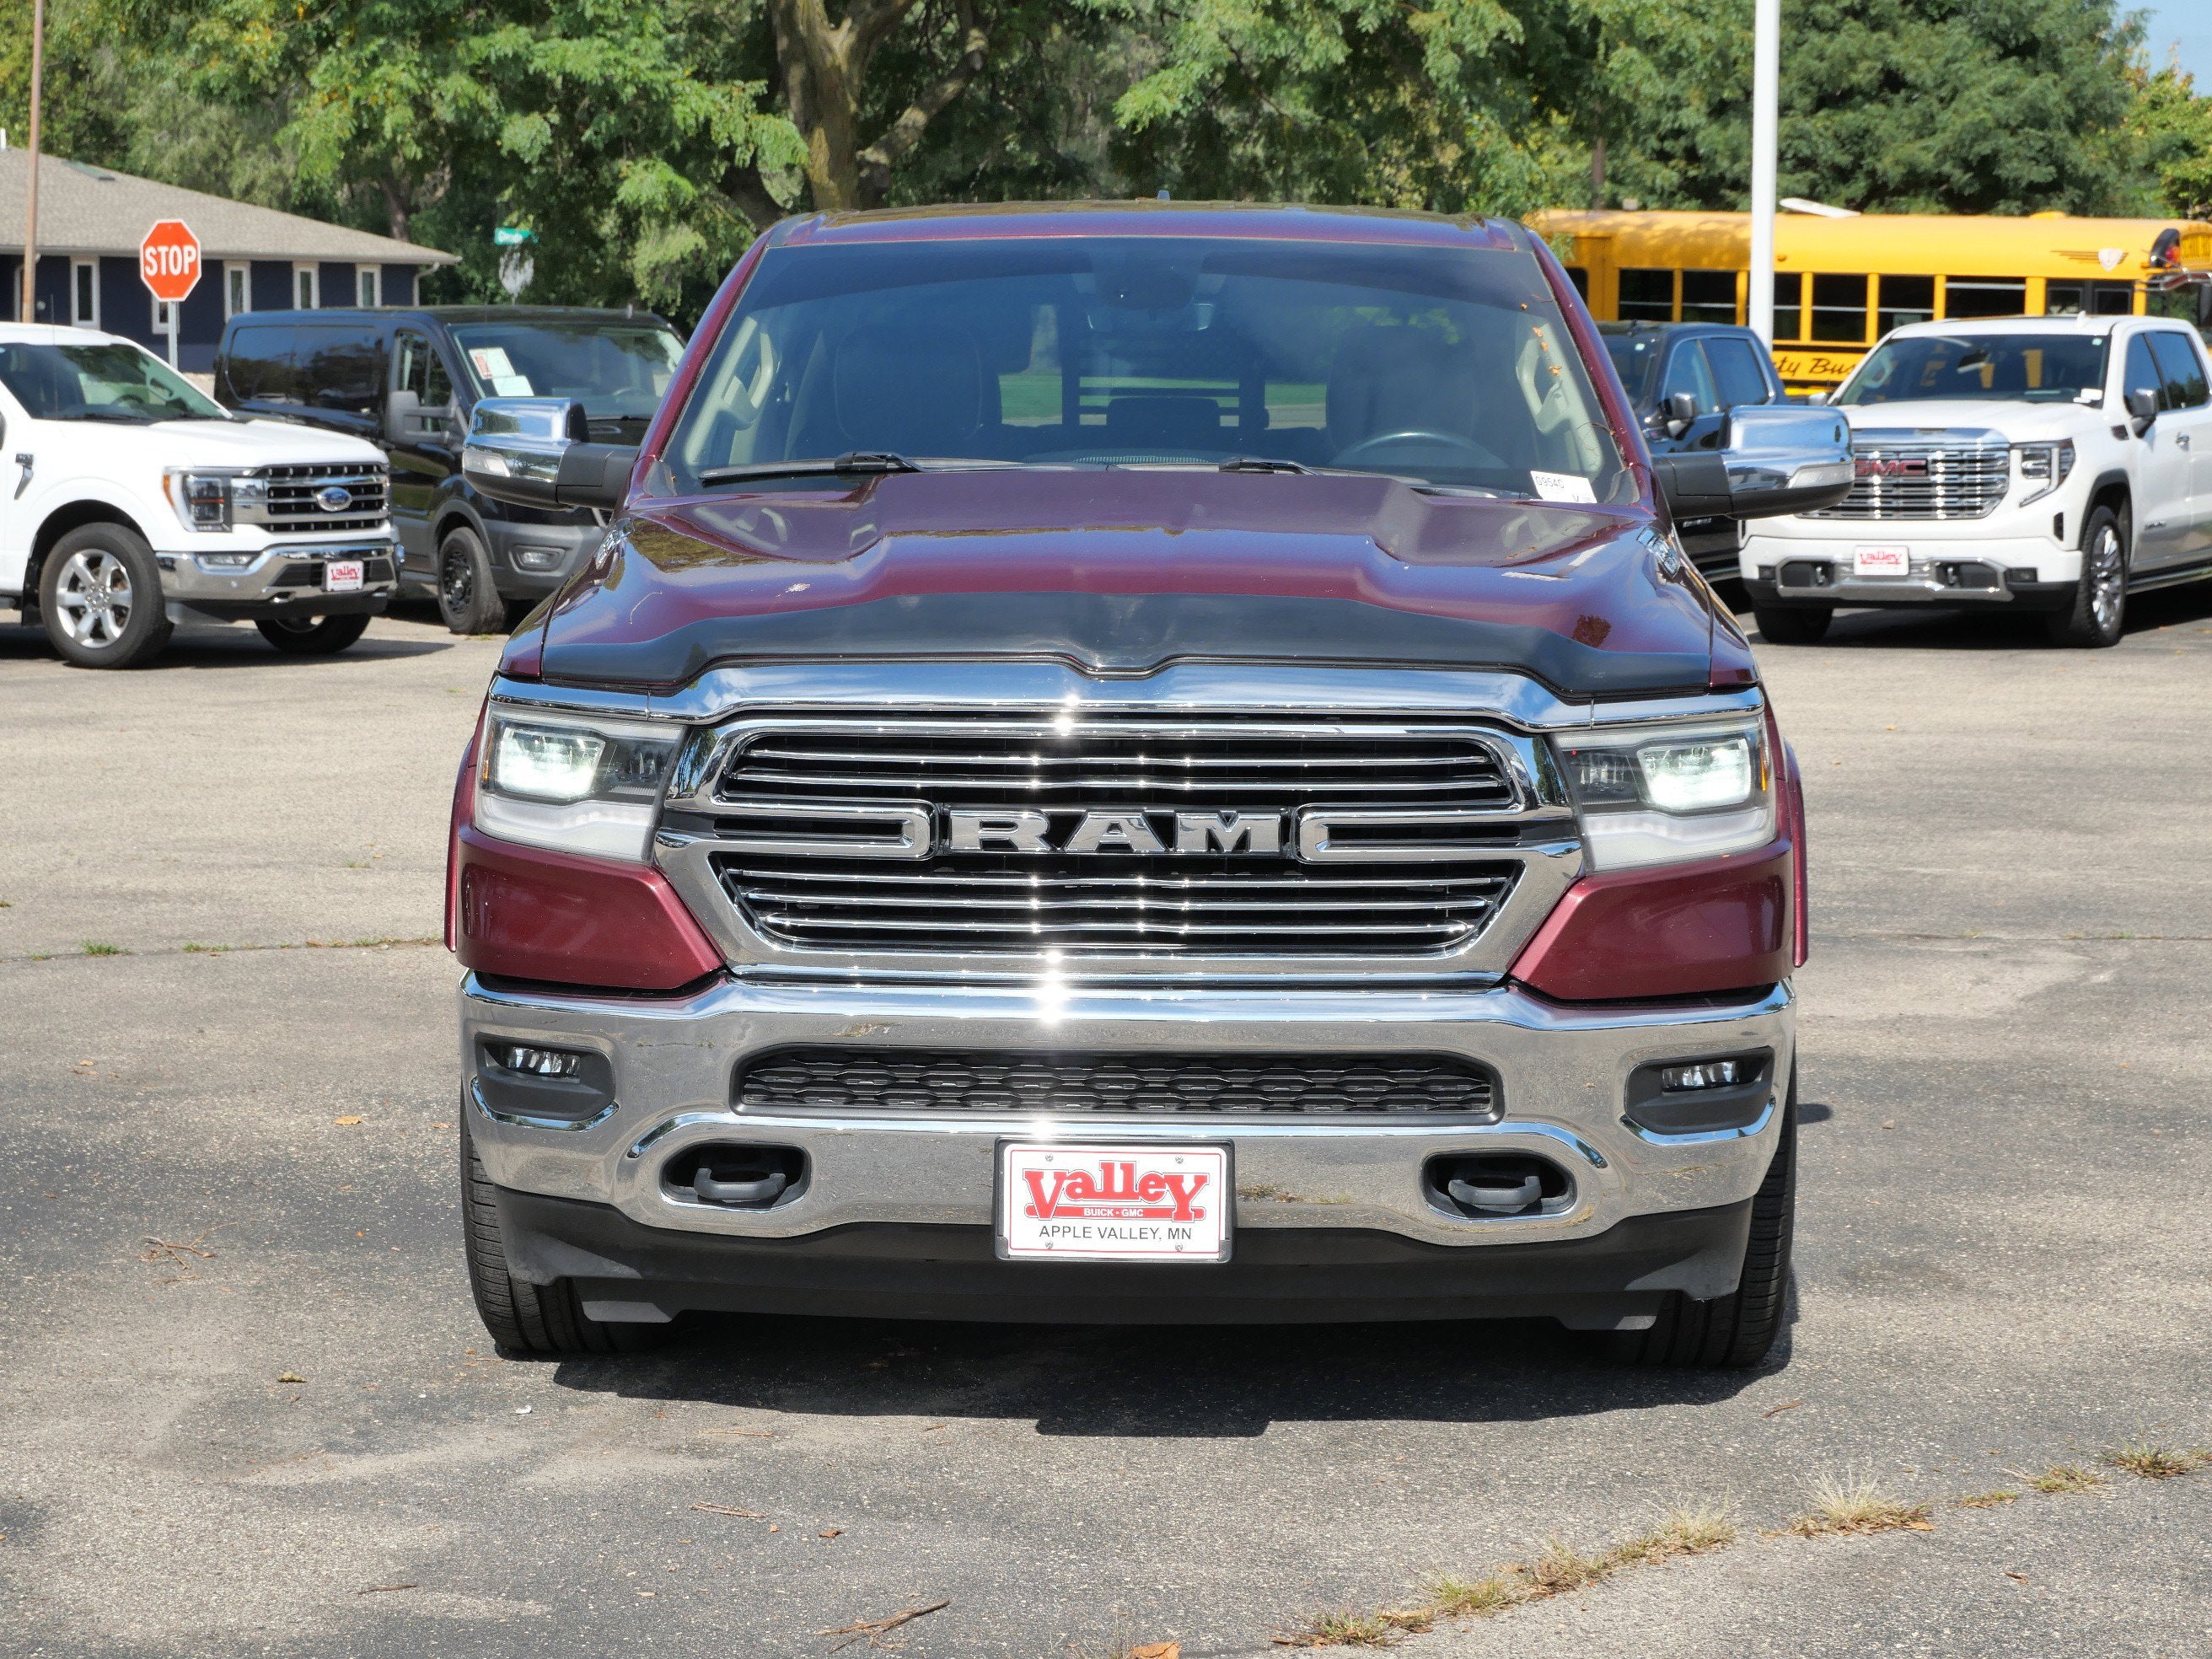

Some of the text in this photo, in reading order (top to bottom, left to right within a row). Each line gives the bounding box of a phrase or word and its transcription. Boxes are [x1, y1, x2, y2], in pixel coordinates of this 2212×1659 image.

[144, 244, 196, 276] STOP
[1855, 459, 1927, 476] GMC
[950, 810, 1281, 853] RAM
[1083, 1207, 1144, 1217] BUICK GMC
[1039, 1225, 1192, 1242] APPLE VALLEY, MN
